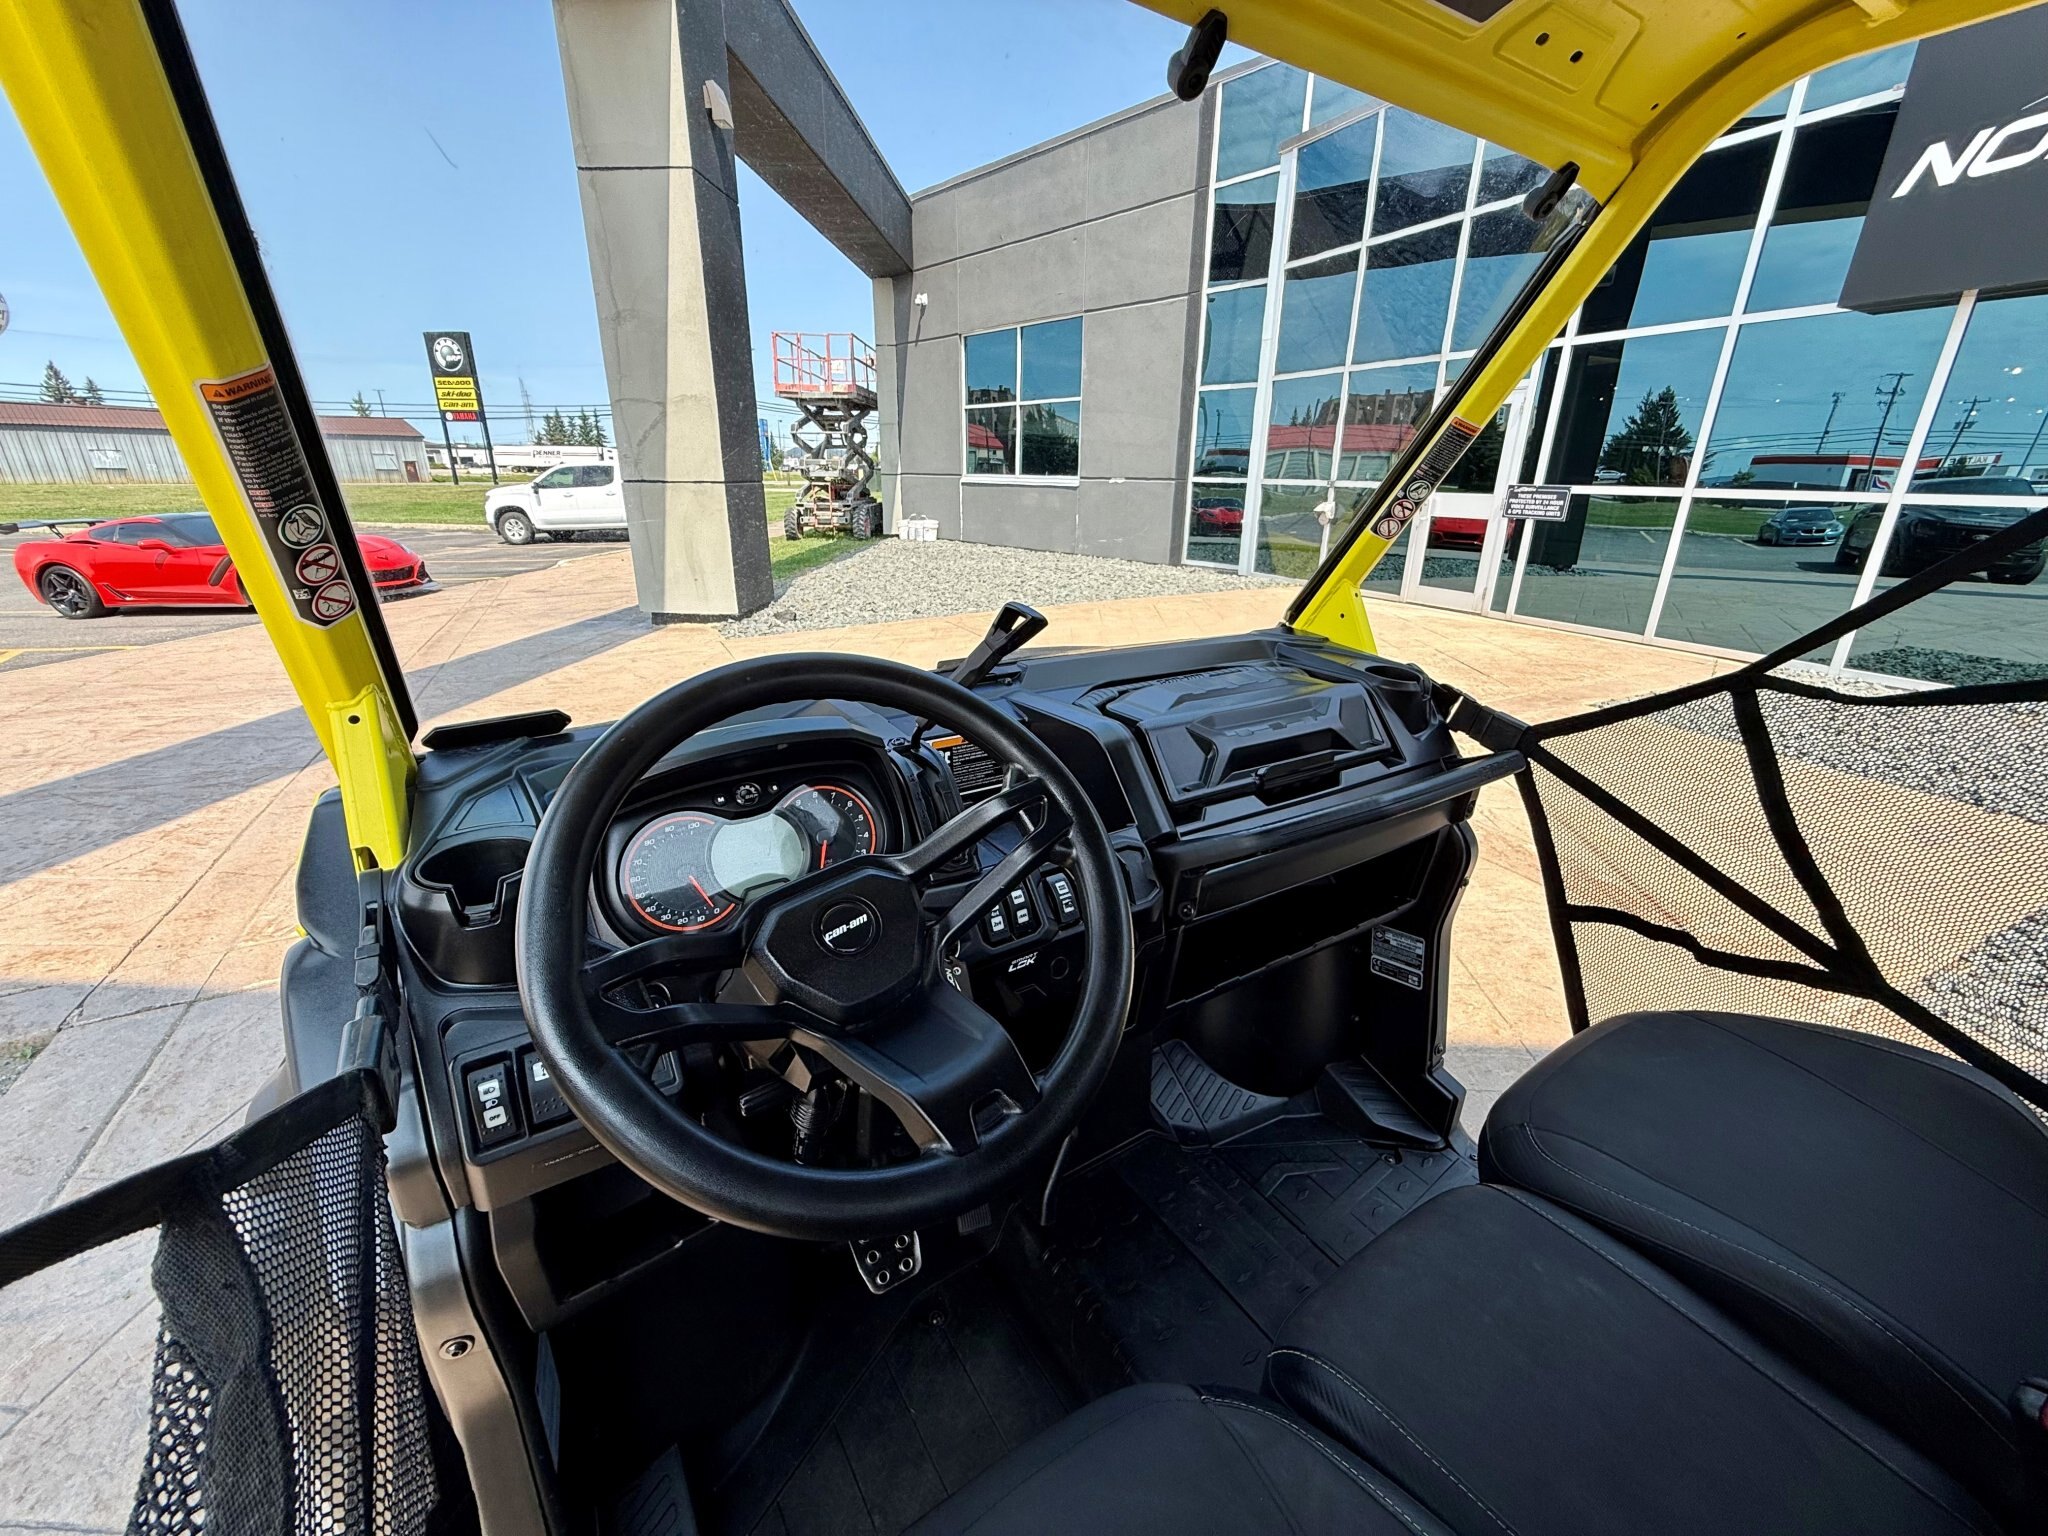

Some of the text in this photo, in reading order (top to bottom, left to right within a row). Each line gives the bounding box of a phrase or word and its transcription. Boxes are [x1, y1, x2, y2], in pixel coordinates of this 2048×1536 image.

[1891, 110, 2048, 199] NO
[453, 412, 477, 420] YAMAHA
[635, 892, 645, 900] 50
[661, 913, 671, 921] 30
[677, 917, 688, 925] 20
[697, 915, 705, 923] 10
[825, 913, 868, 941] can-am
